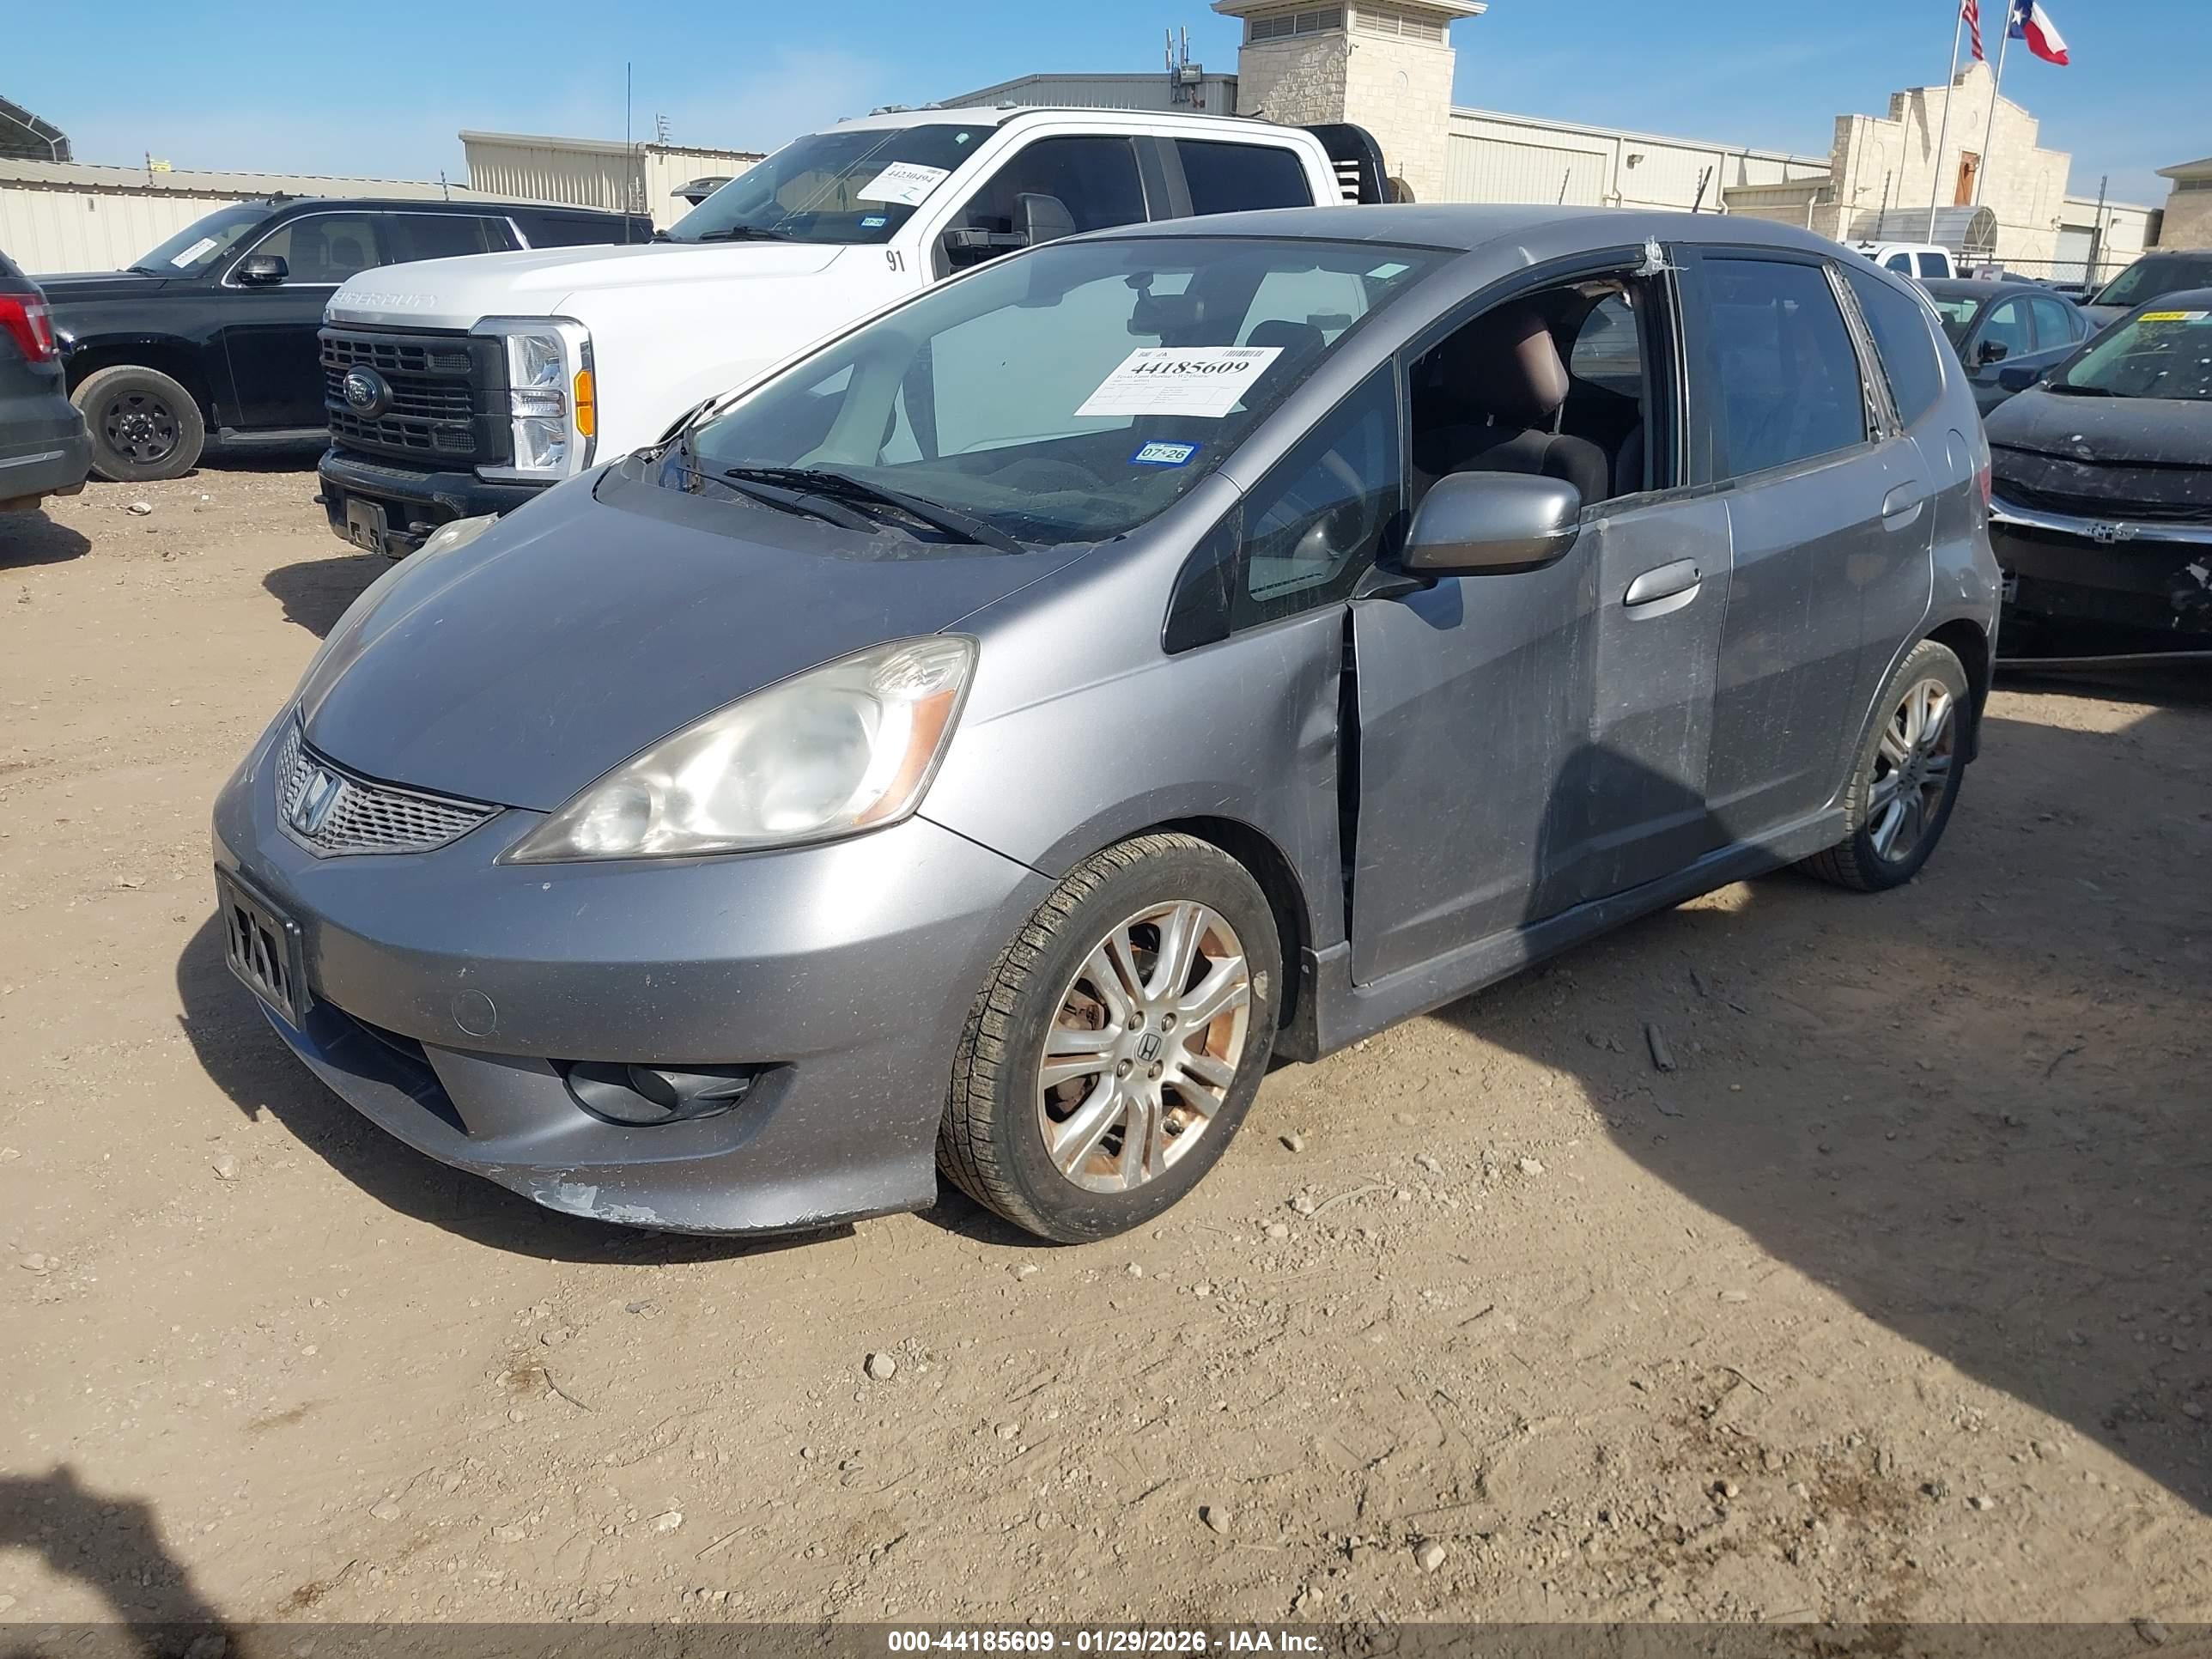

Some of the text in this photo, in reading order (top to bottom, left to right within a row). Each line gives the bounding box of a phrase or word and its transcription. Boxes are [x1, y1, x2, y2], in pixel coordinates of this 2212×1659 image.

[886, 250, 905, 271] 91
[332, 291, 438, 308] SUPER DUTY
[1132, 362, 1249, 374] 44185609
